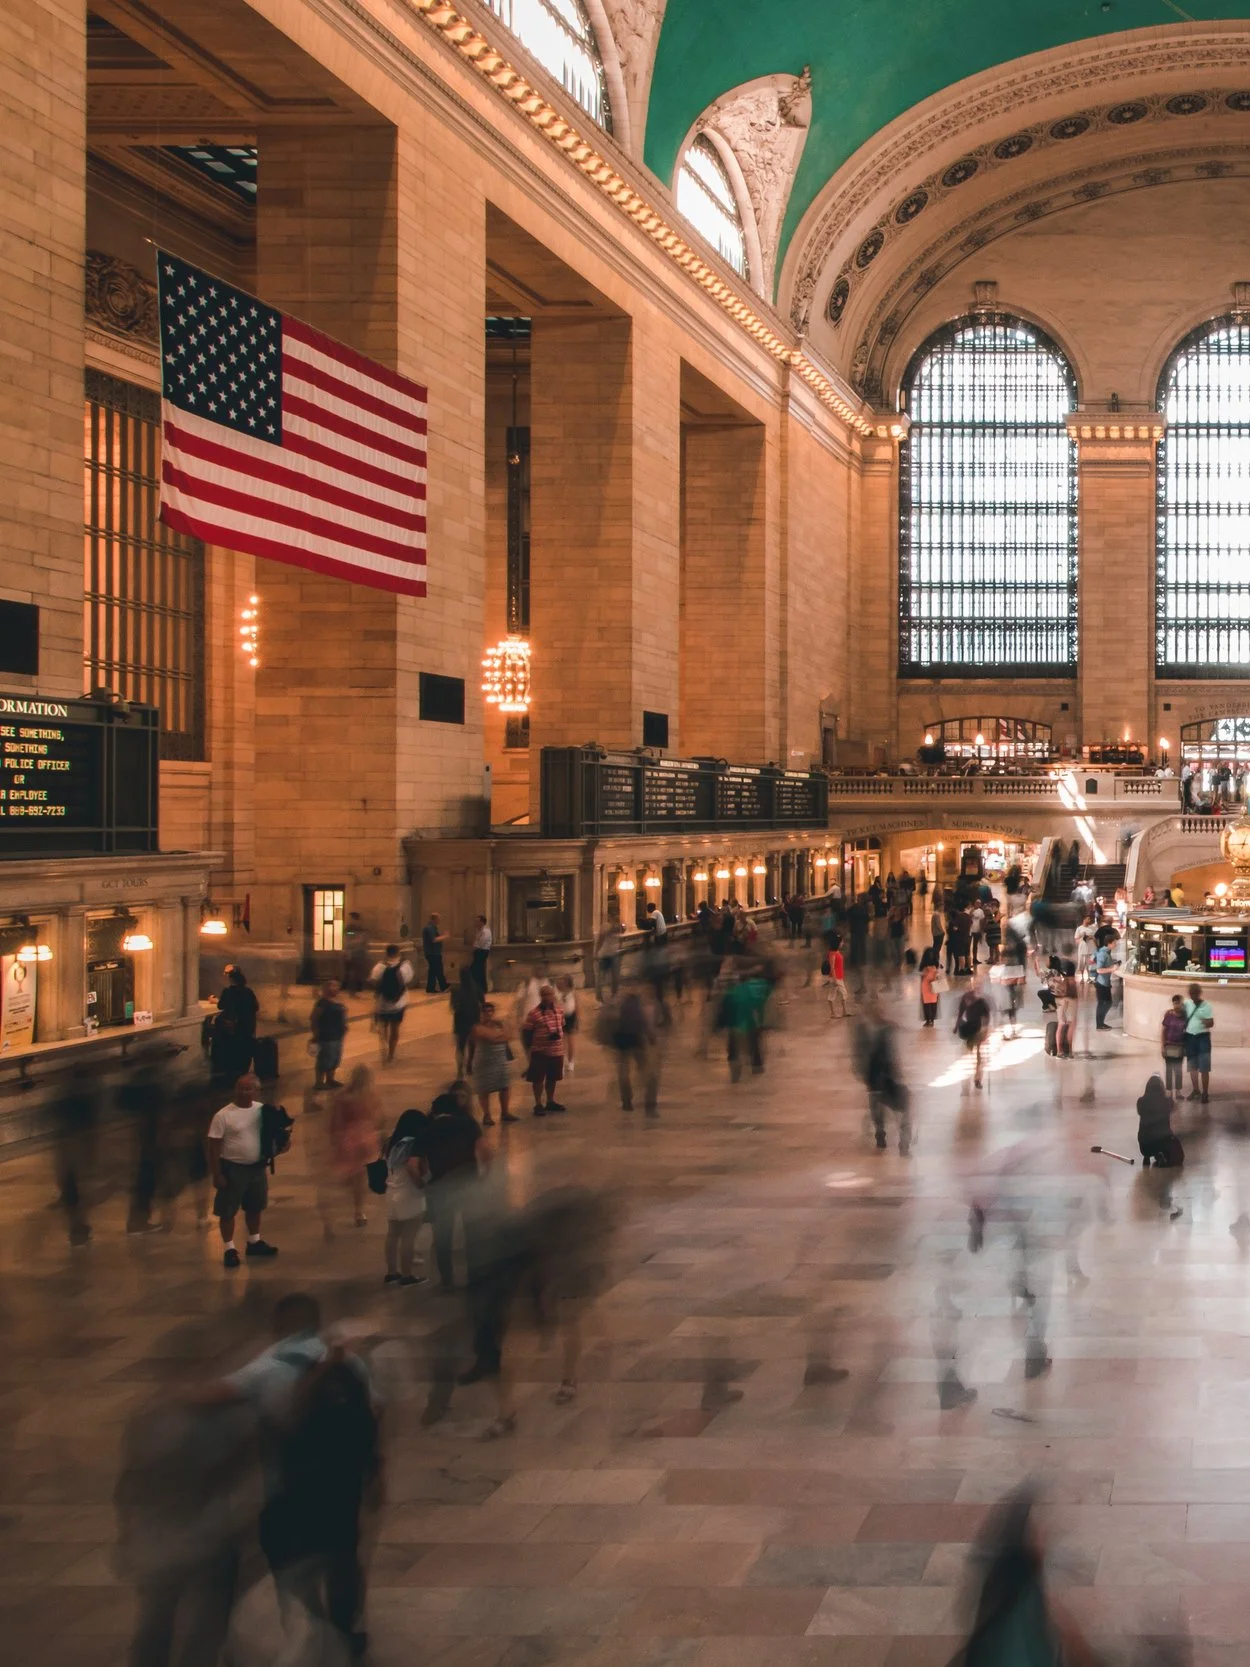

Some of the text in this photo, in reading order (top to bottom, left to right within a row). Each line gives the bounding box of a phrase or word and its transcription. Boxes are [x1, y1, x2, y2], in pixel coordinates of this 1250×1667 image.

[0, 699, 68, 717] ORMATION
[0, 726, 15, 737] SEE
[4, 742, 48, 755] SOMETHING
[4, 758, 70, 771] POLICE OFFICER
[13, 774, 25, 785] OR
[9, 789, 48, 800] EMPLOYEE
